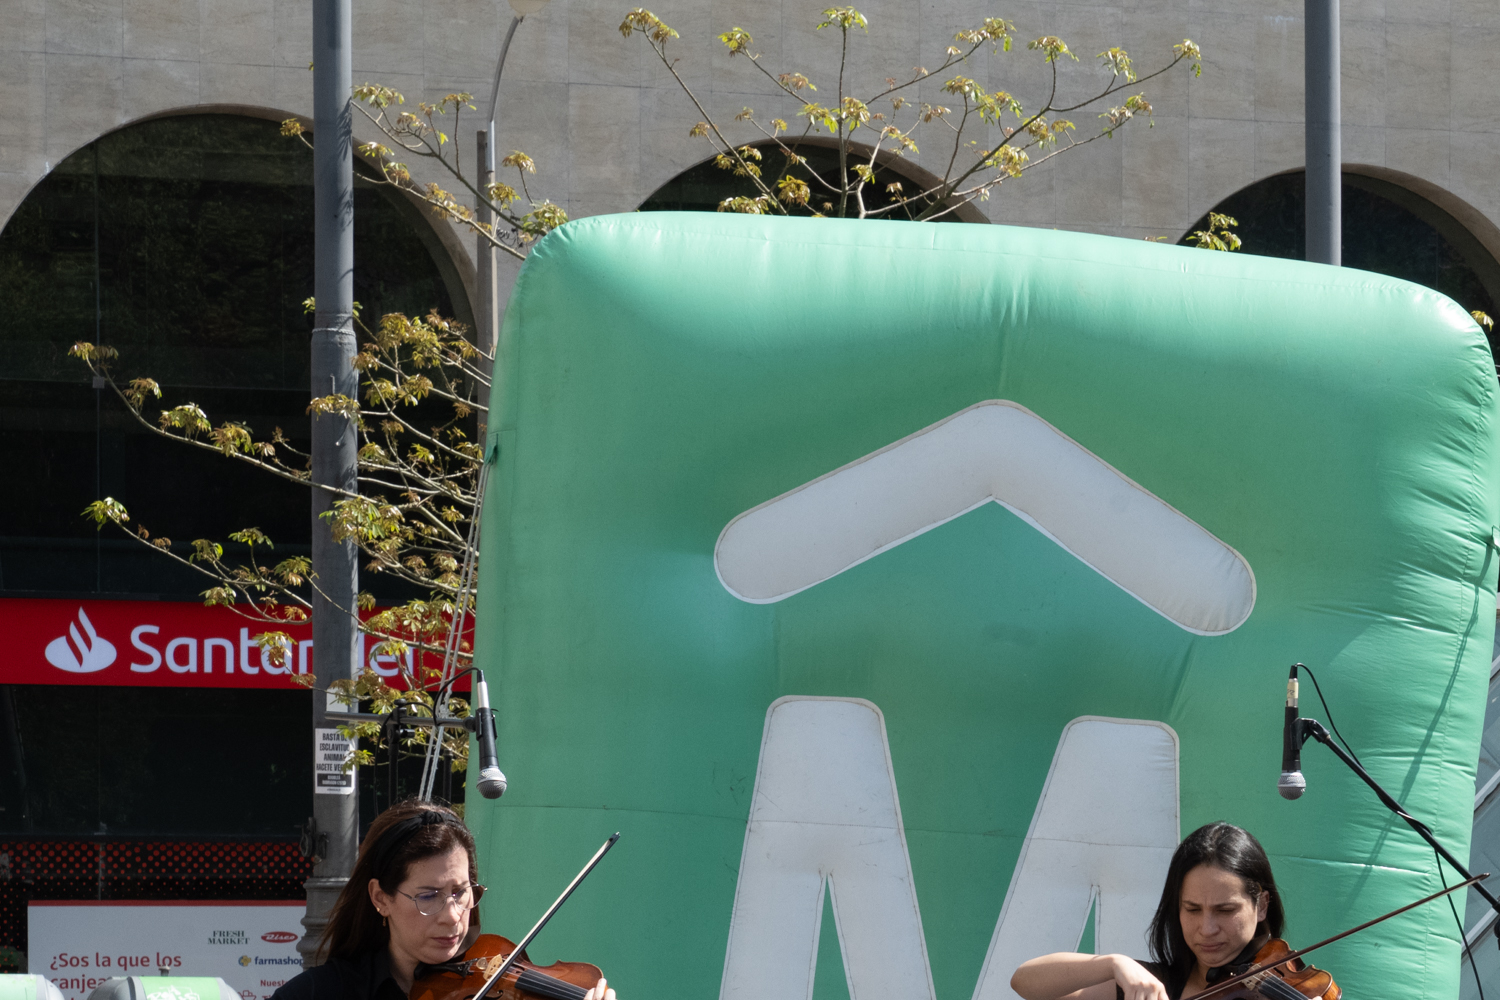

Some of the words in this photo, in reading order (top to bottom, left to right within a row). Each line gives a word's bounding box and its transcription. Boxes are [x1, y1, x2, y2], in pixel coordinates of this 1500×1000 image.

[50, 953, 89, 970] ¿Sos
[96, 952, 111, 967] la
[117, 955, 150, 971] que
[156, 952, 182, 967] los
